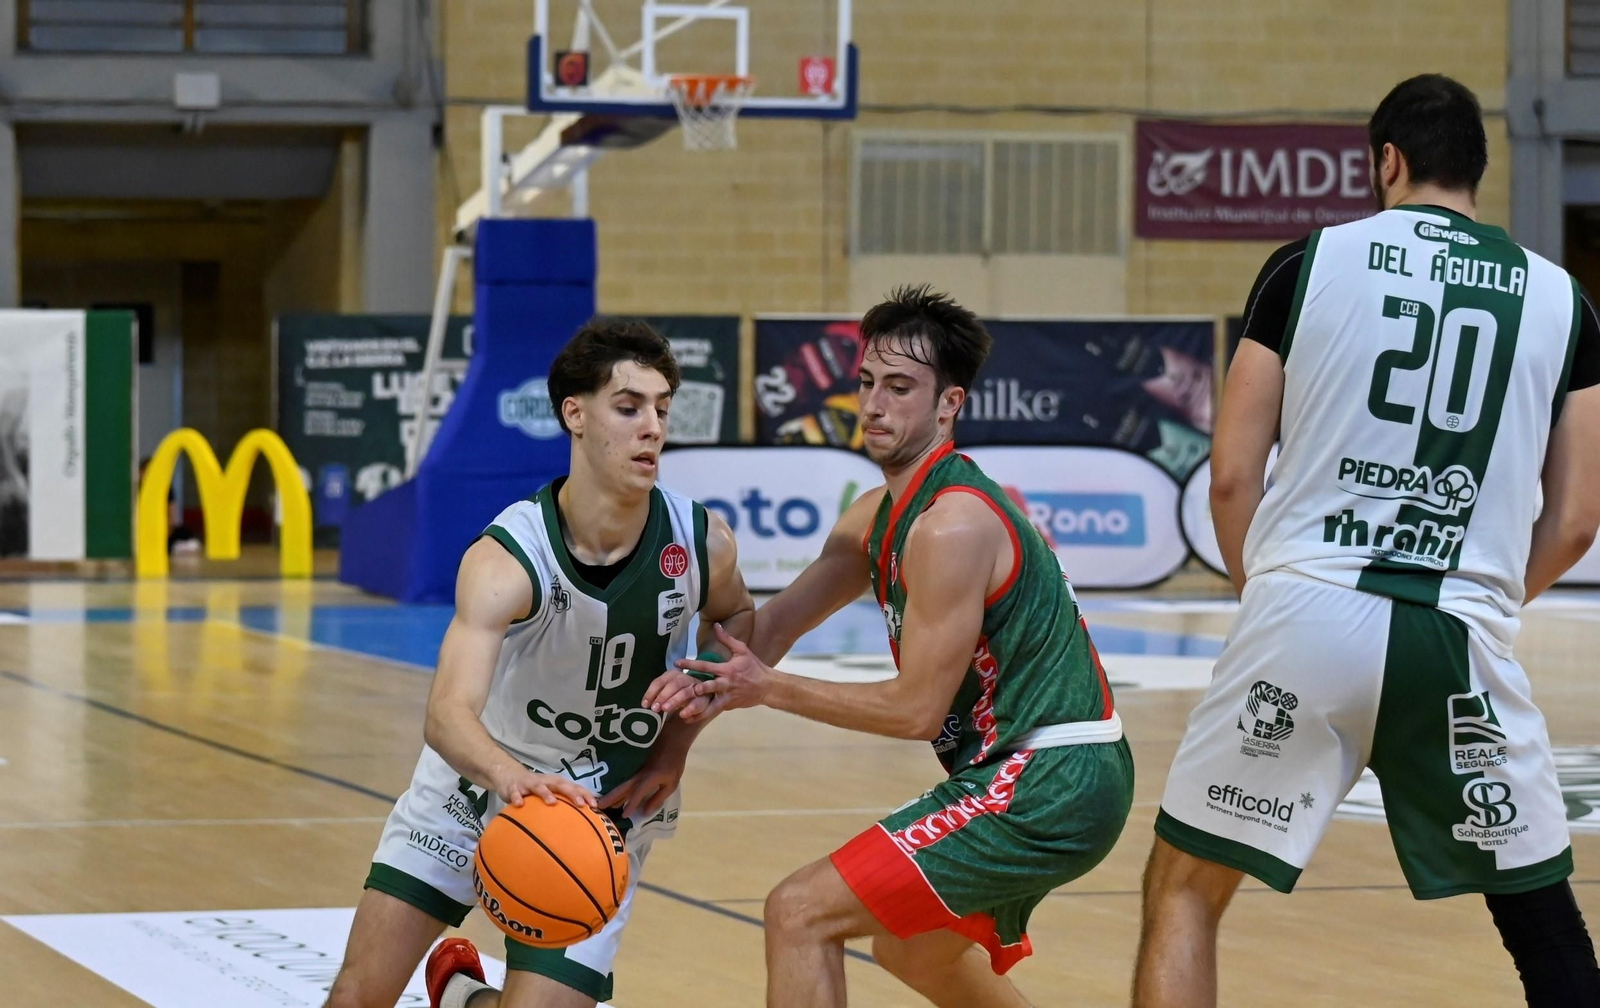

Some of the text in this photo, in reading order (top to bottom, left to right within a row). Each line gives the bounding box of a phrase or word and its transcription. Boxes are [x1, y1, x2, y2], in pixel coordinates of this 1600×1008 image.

[1220, 147, 1369, 198] IMDE
[1418, 223, 1480, 245] GEWISS
[1368, 242, 1526, 297] DEL ÁGUILA
[1399, 300, 1420, 316] CCB
[1367, 294, 1498, 433] 20
[702, 488, 821, 539] oto
[585, 632, 636, 690] 18
[526, 699, 659, 745] coto
[1454, 746, 1507, 761] REALE
[1456, 756, 1508, 770] SEGUROS
[1206, 801, 1288, 833] Partners beyond the cold
[1207, 784, 1294, 823] efficold
[409, 829, 468, 868] IMDECO
[1457, 824, 1529, 839] SohoBoutique
[1481, 838, 1508, 847] HOTELS
[473, 862, 543, 939] Wilson
